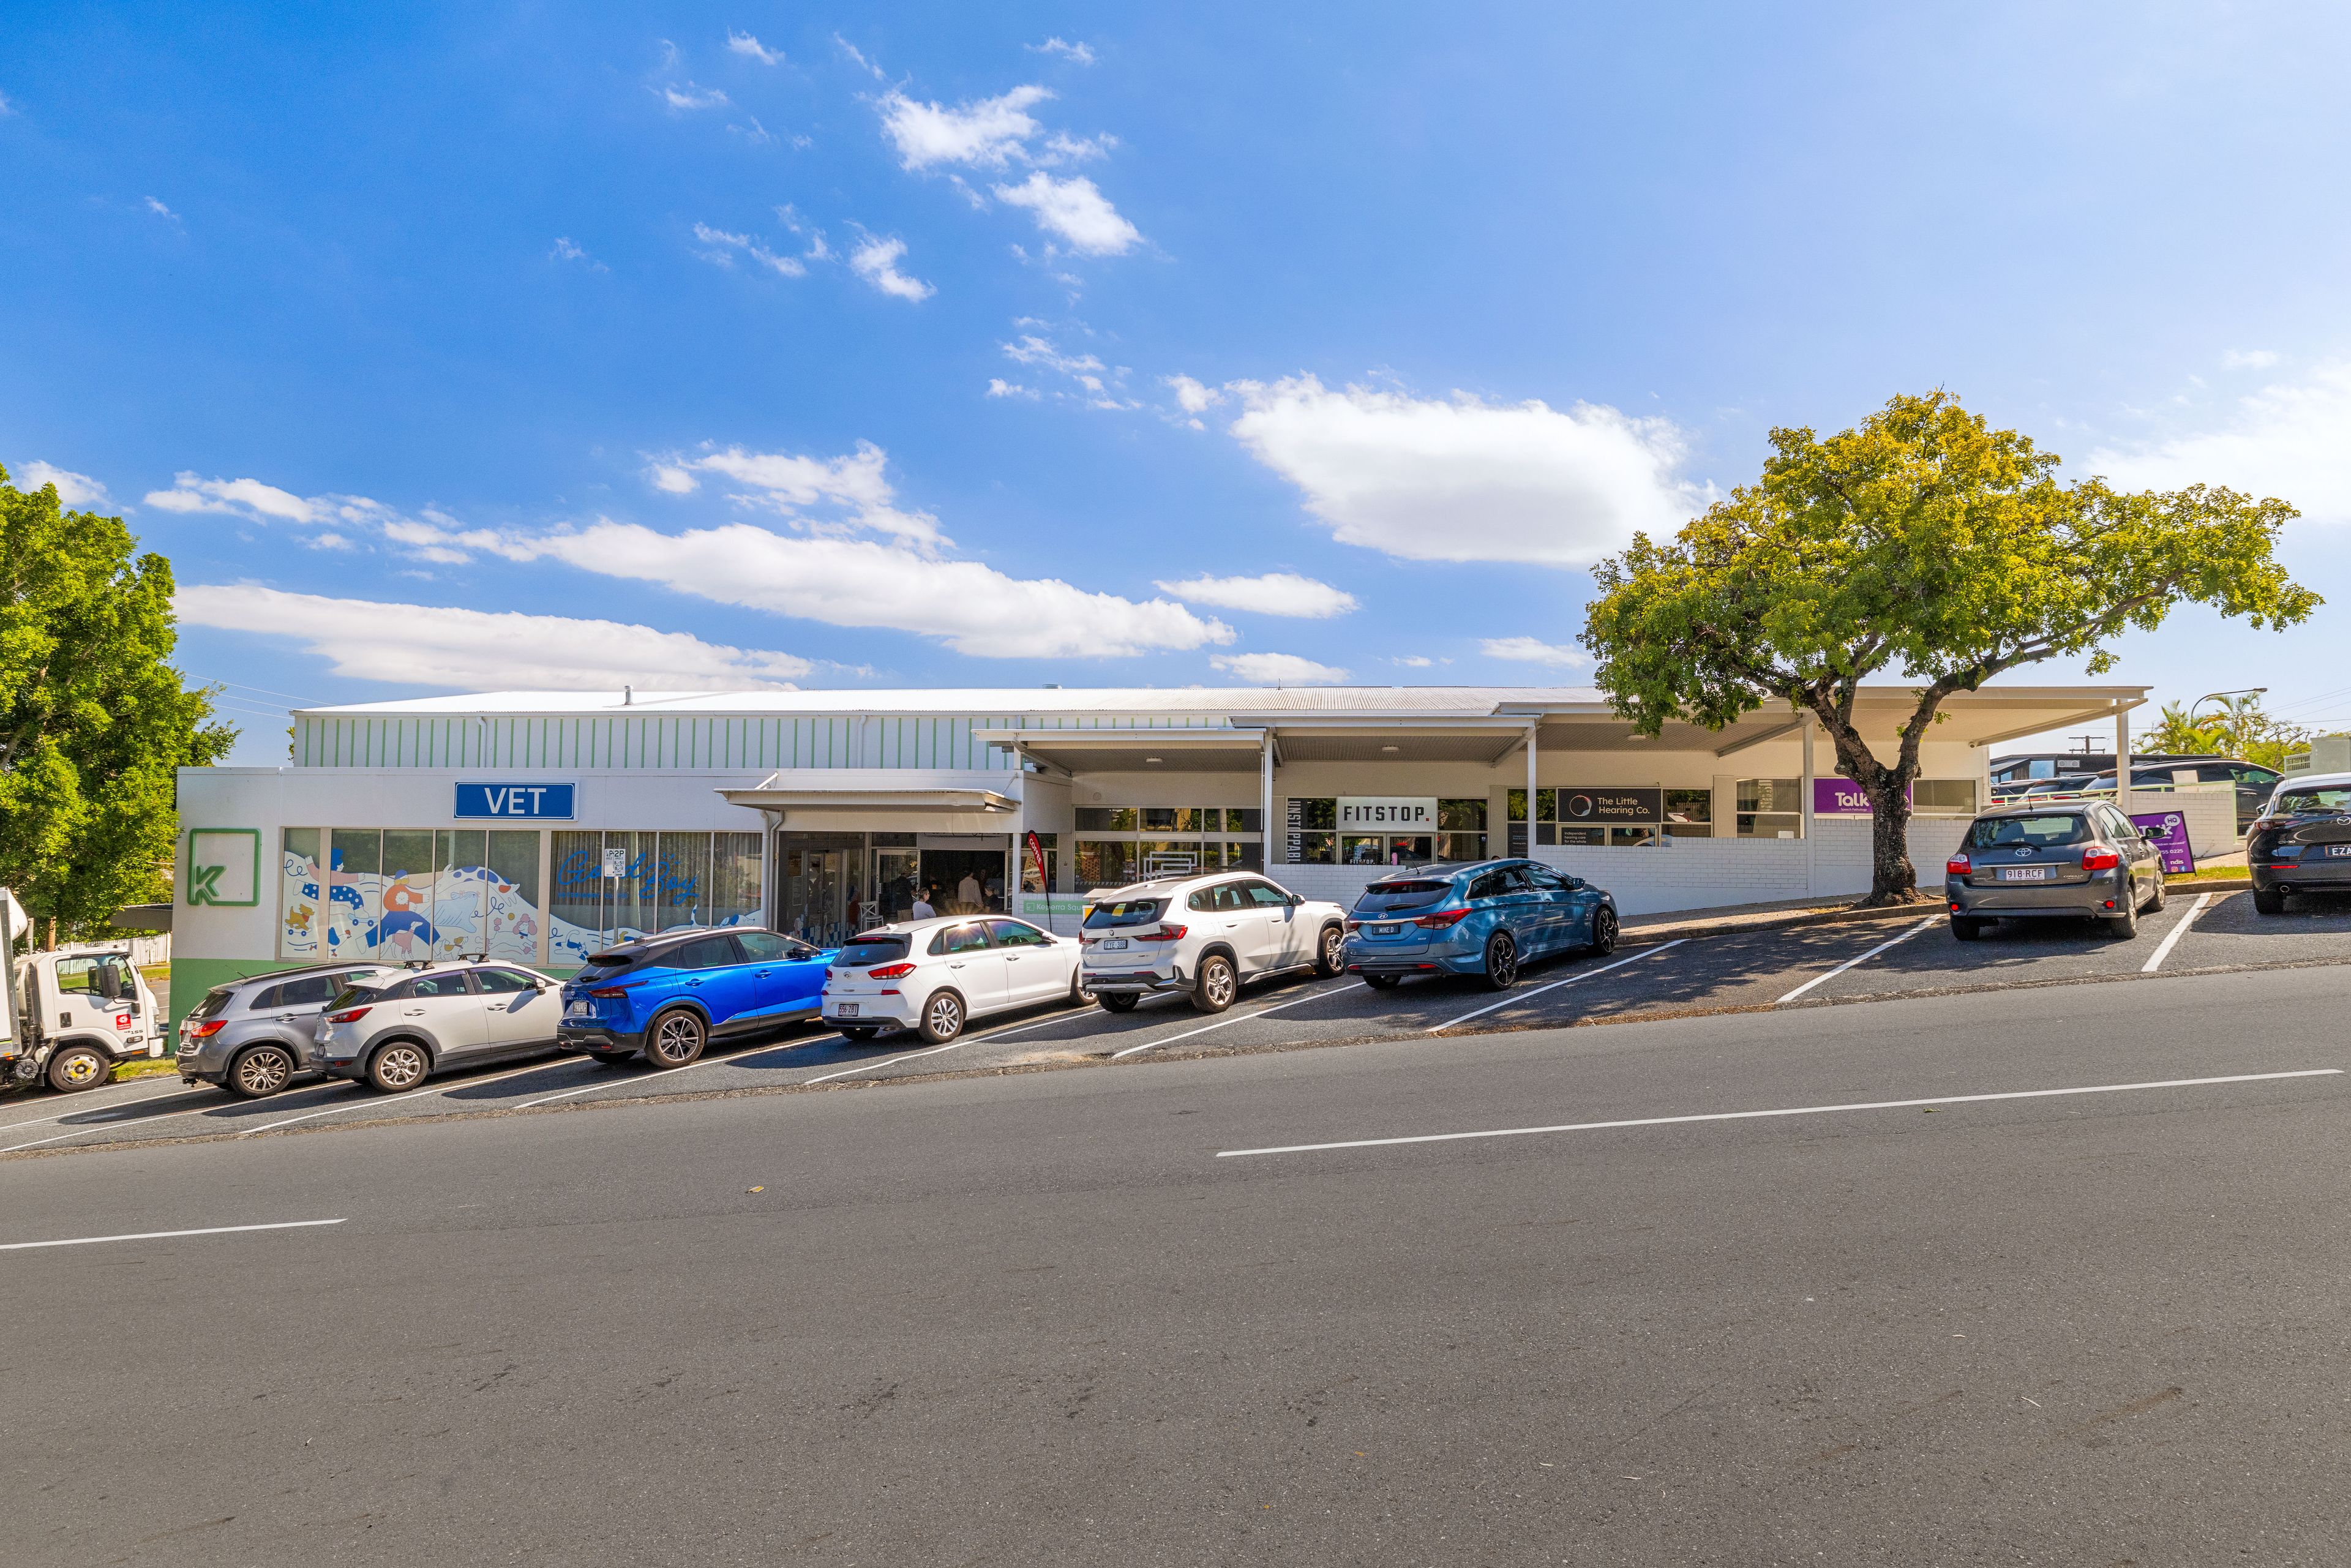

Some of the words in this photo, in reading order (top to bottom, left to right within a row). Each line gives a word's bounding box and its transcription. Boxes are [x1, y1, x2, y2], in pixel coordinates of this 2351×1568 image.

[484, 787, 547, 814] VET
[1835, 792, 1869, 807] Talk
[1344, 806, 1430, 822] FITSTOP.
[1599, 806, 1633, 816] Hearing
[1029, 838, 1041, 865] COFFEE
[558, 850, 647, 885] God
